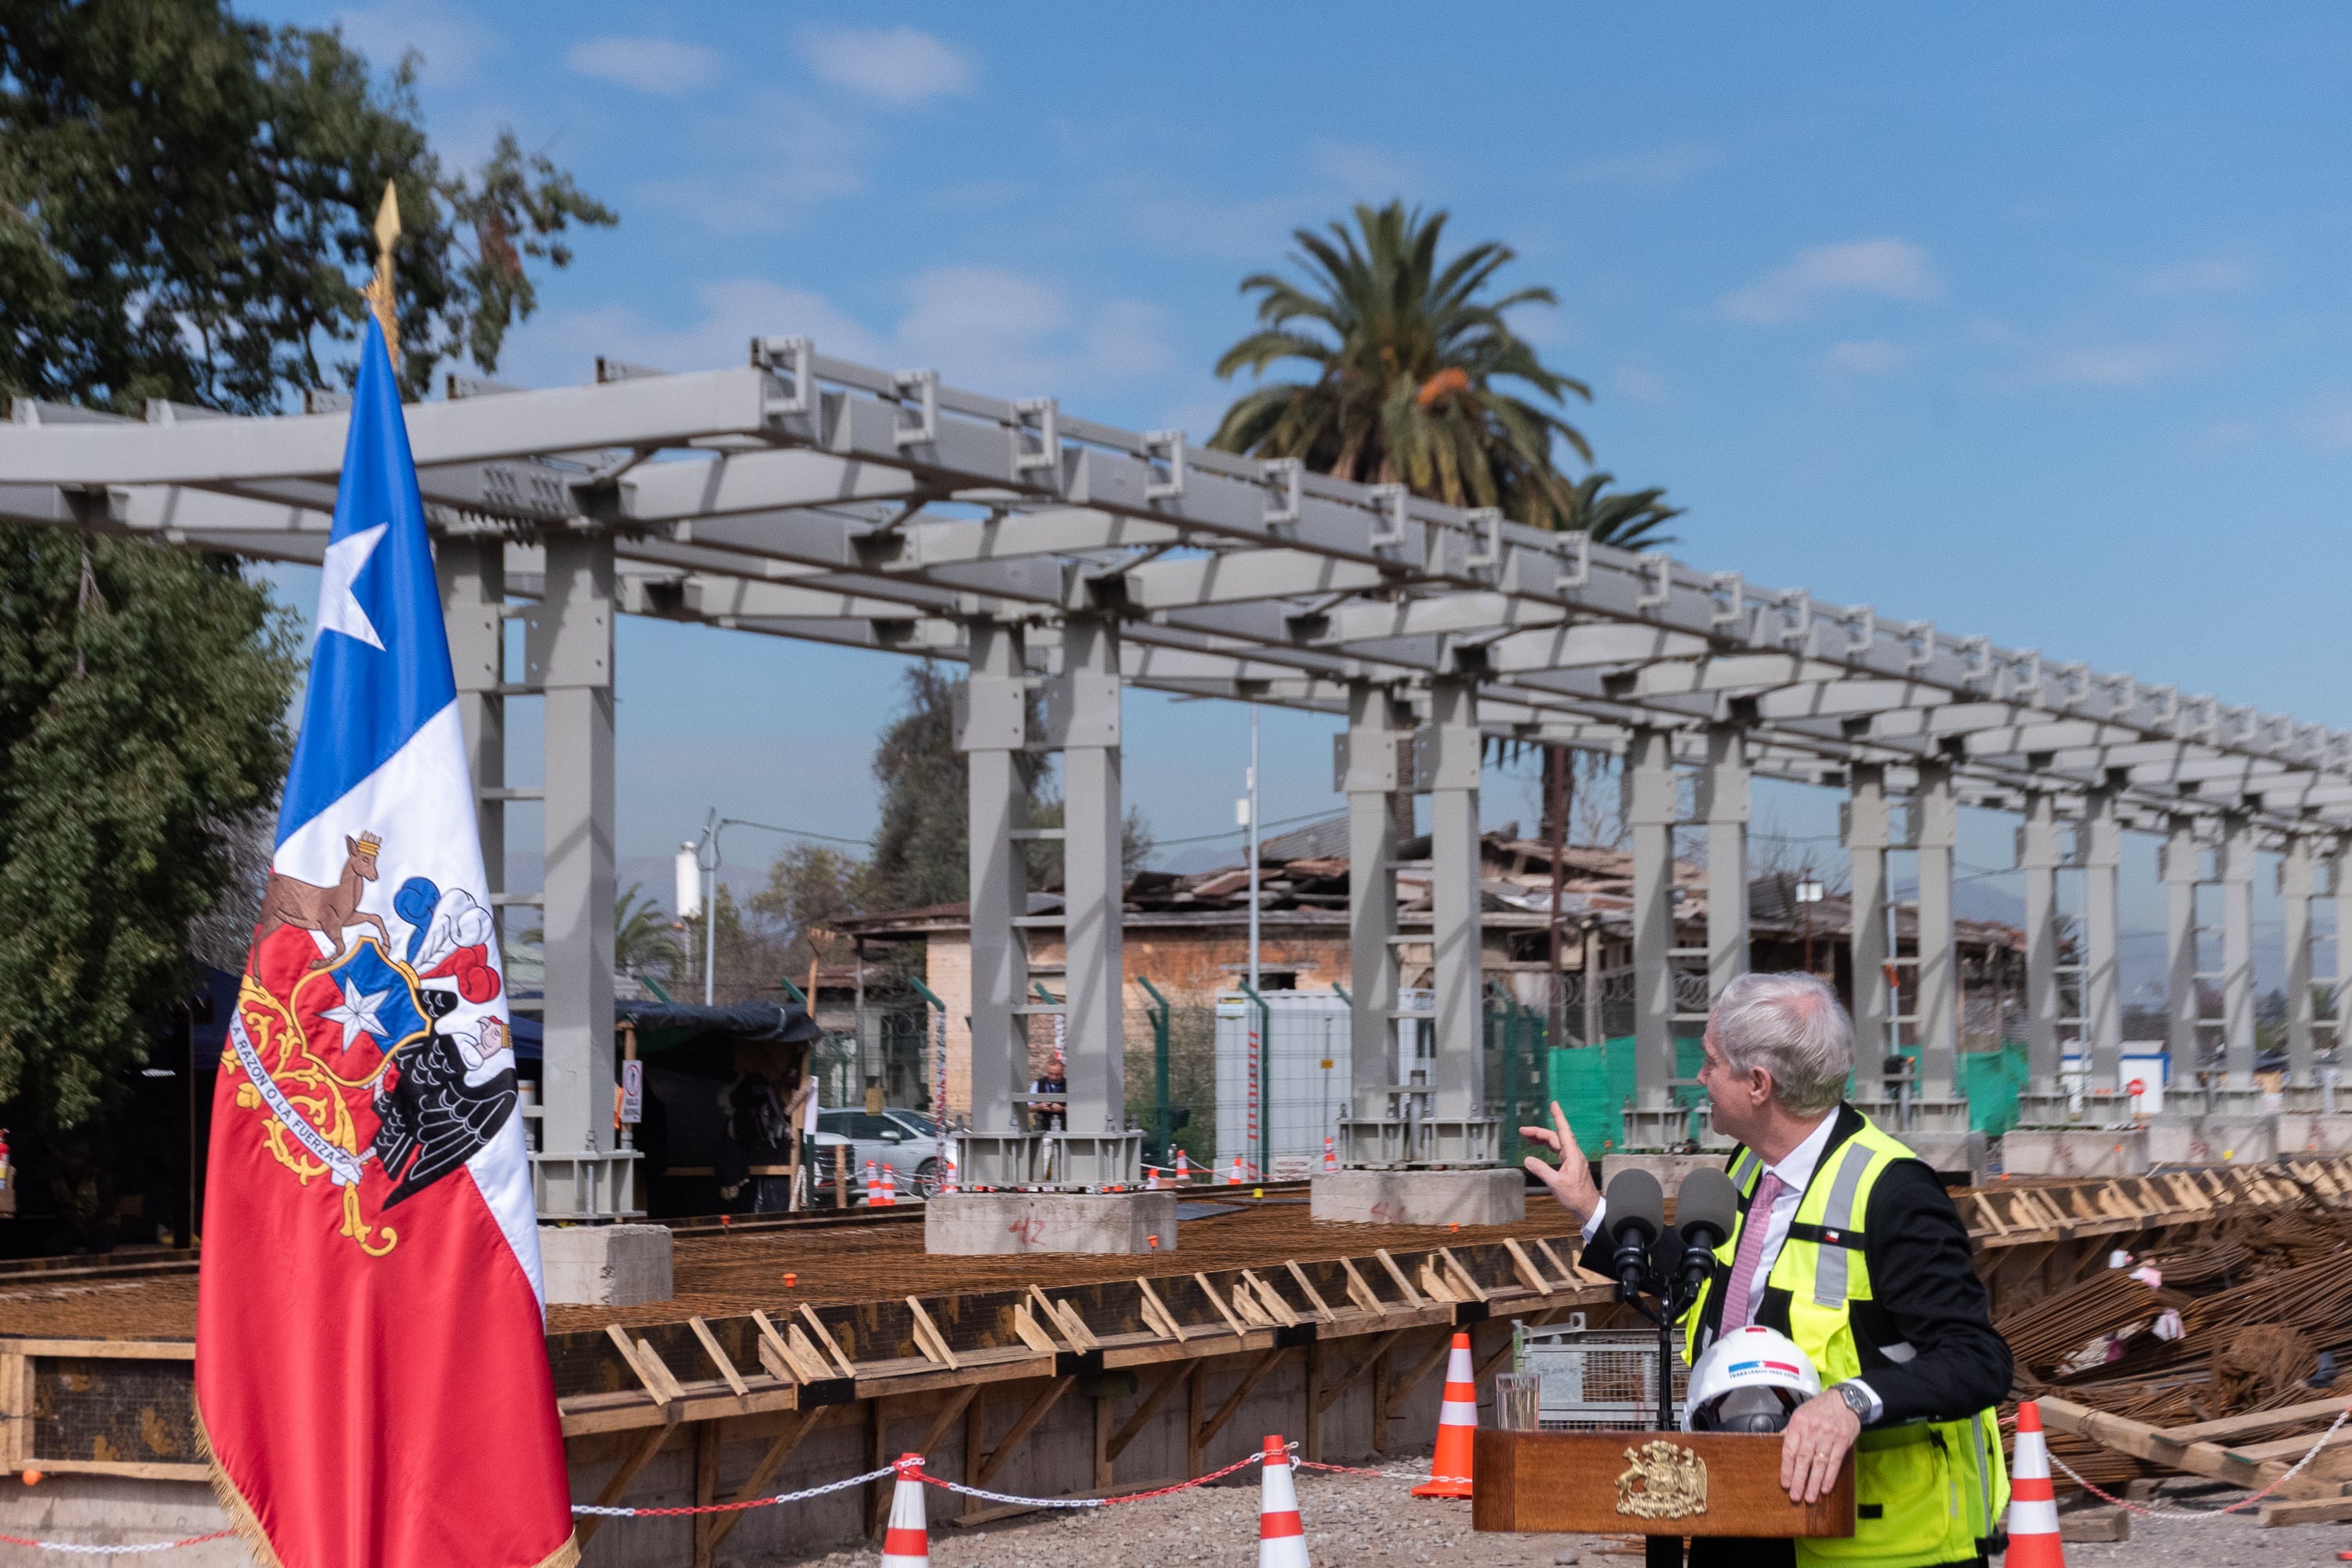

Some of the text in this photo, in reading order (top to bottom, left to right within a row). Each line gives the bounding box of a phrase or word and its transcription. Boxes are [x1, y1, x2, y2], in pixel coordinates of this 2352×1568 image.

[238, 1040, 268, 1087] RAZON
[267, 1089, 278, 1099] O
[276, 1101, 291, 1120] LA
[292, 1120, 335, 1163] FUERZA
[1008, 1217, 1047, 1245] 42
